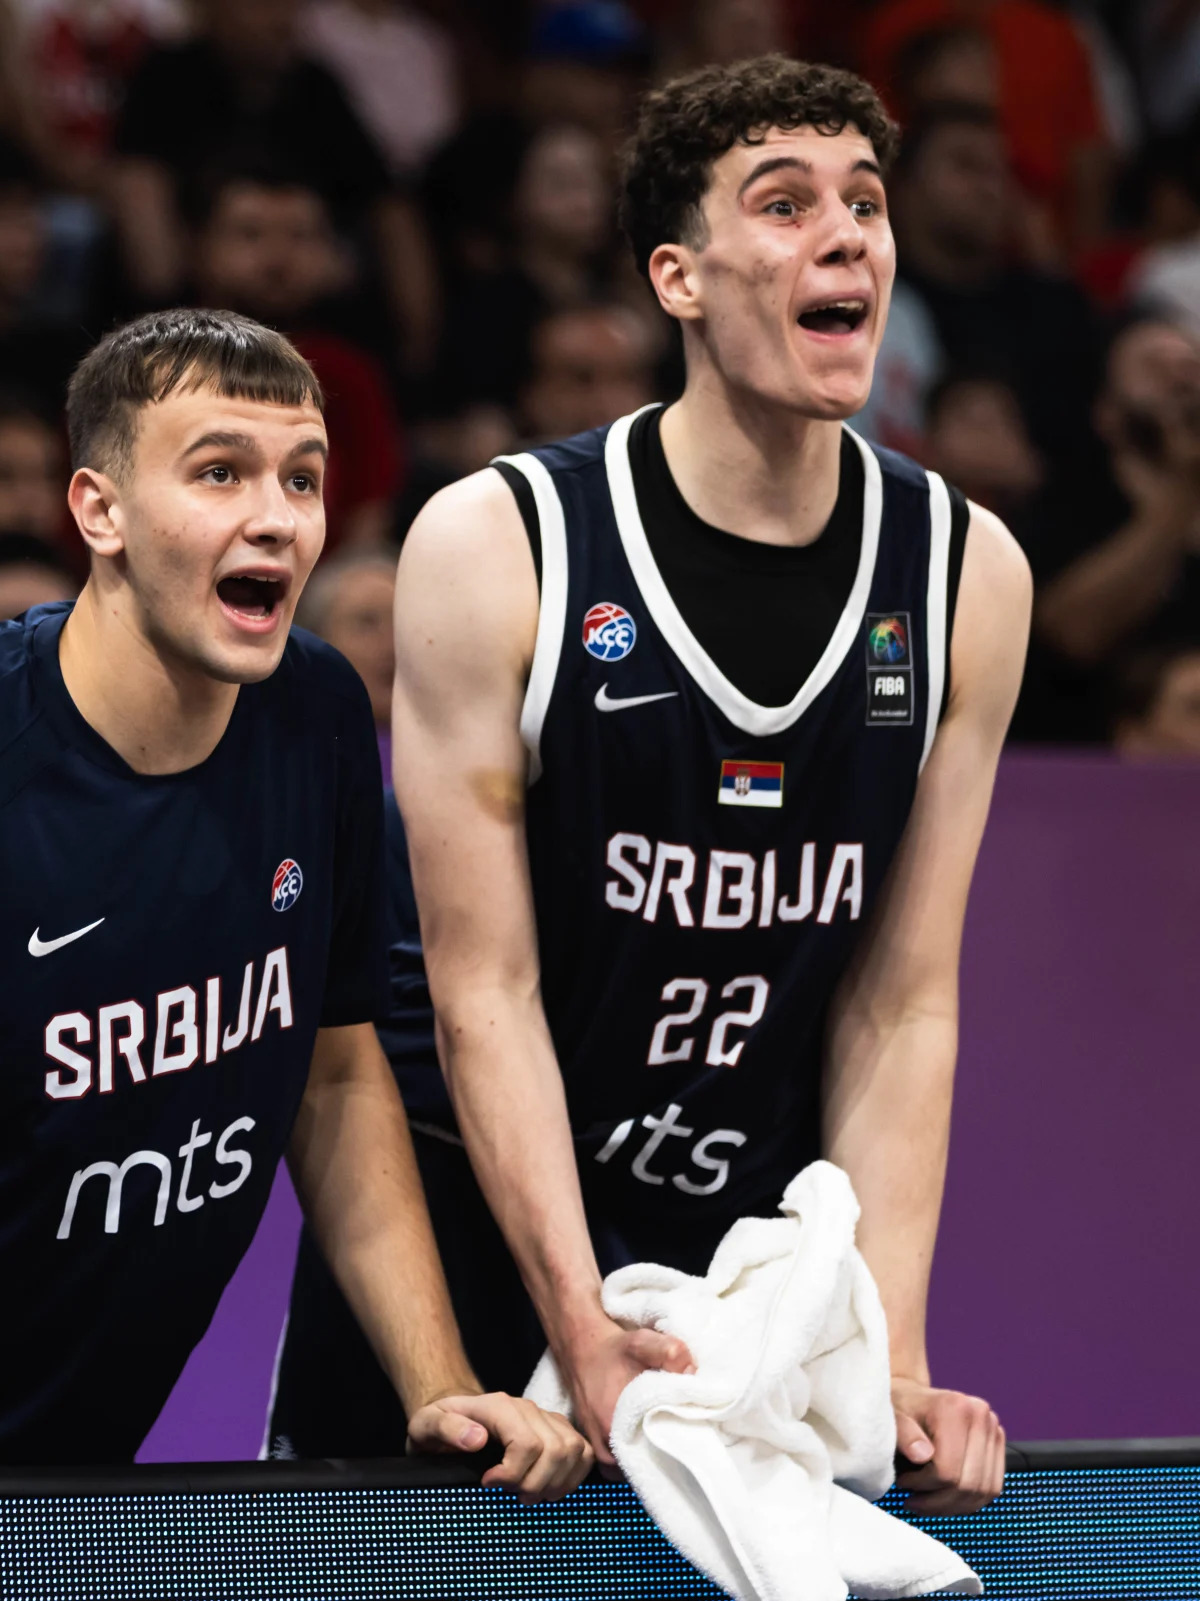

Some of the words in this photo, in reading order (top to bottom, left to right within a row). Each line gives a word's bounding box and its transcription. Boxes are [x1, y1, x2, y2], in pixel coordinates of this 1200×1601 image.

[588, 628, 629, 648] KCC
[874, 676, 905, 696] FIBA
[274, 878, 298, 902] KCC
[605, 832, 864, 929] SRBIJA
[44, 946, 294, 1100] SRBIJA
[647, 975, 770, 1068] 22
[56, 1115, 256, 1240] mts
[595, 1103, 747, 1196] ts
